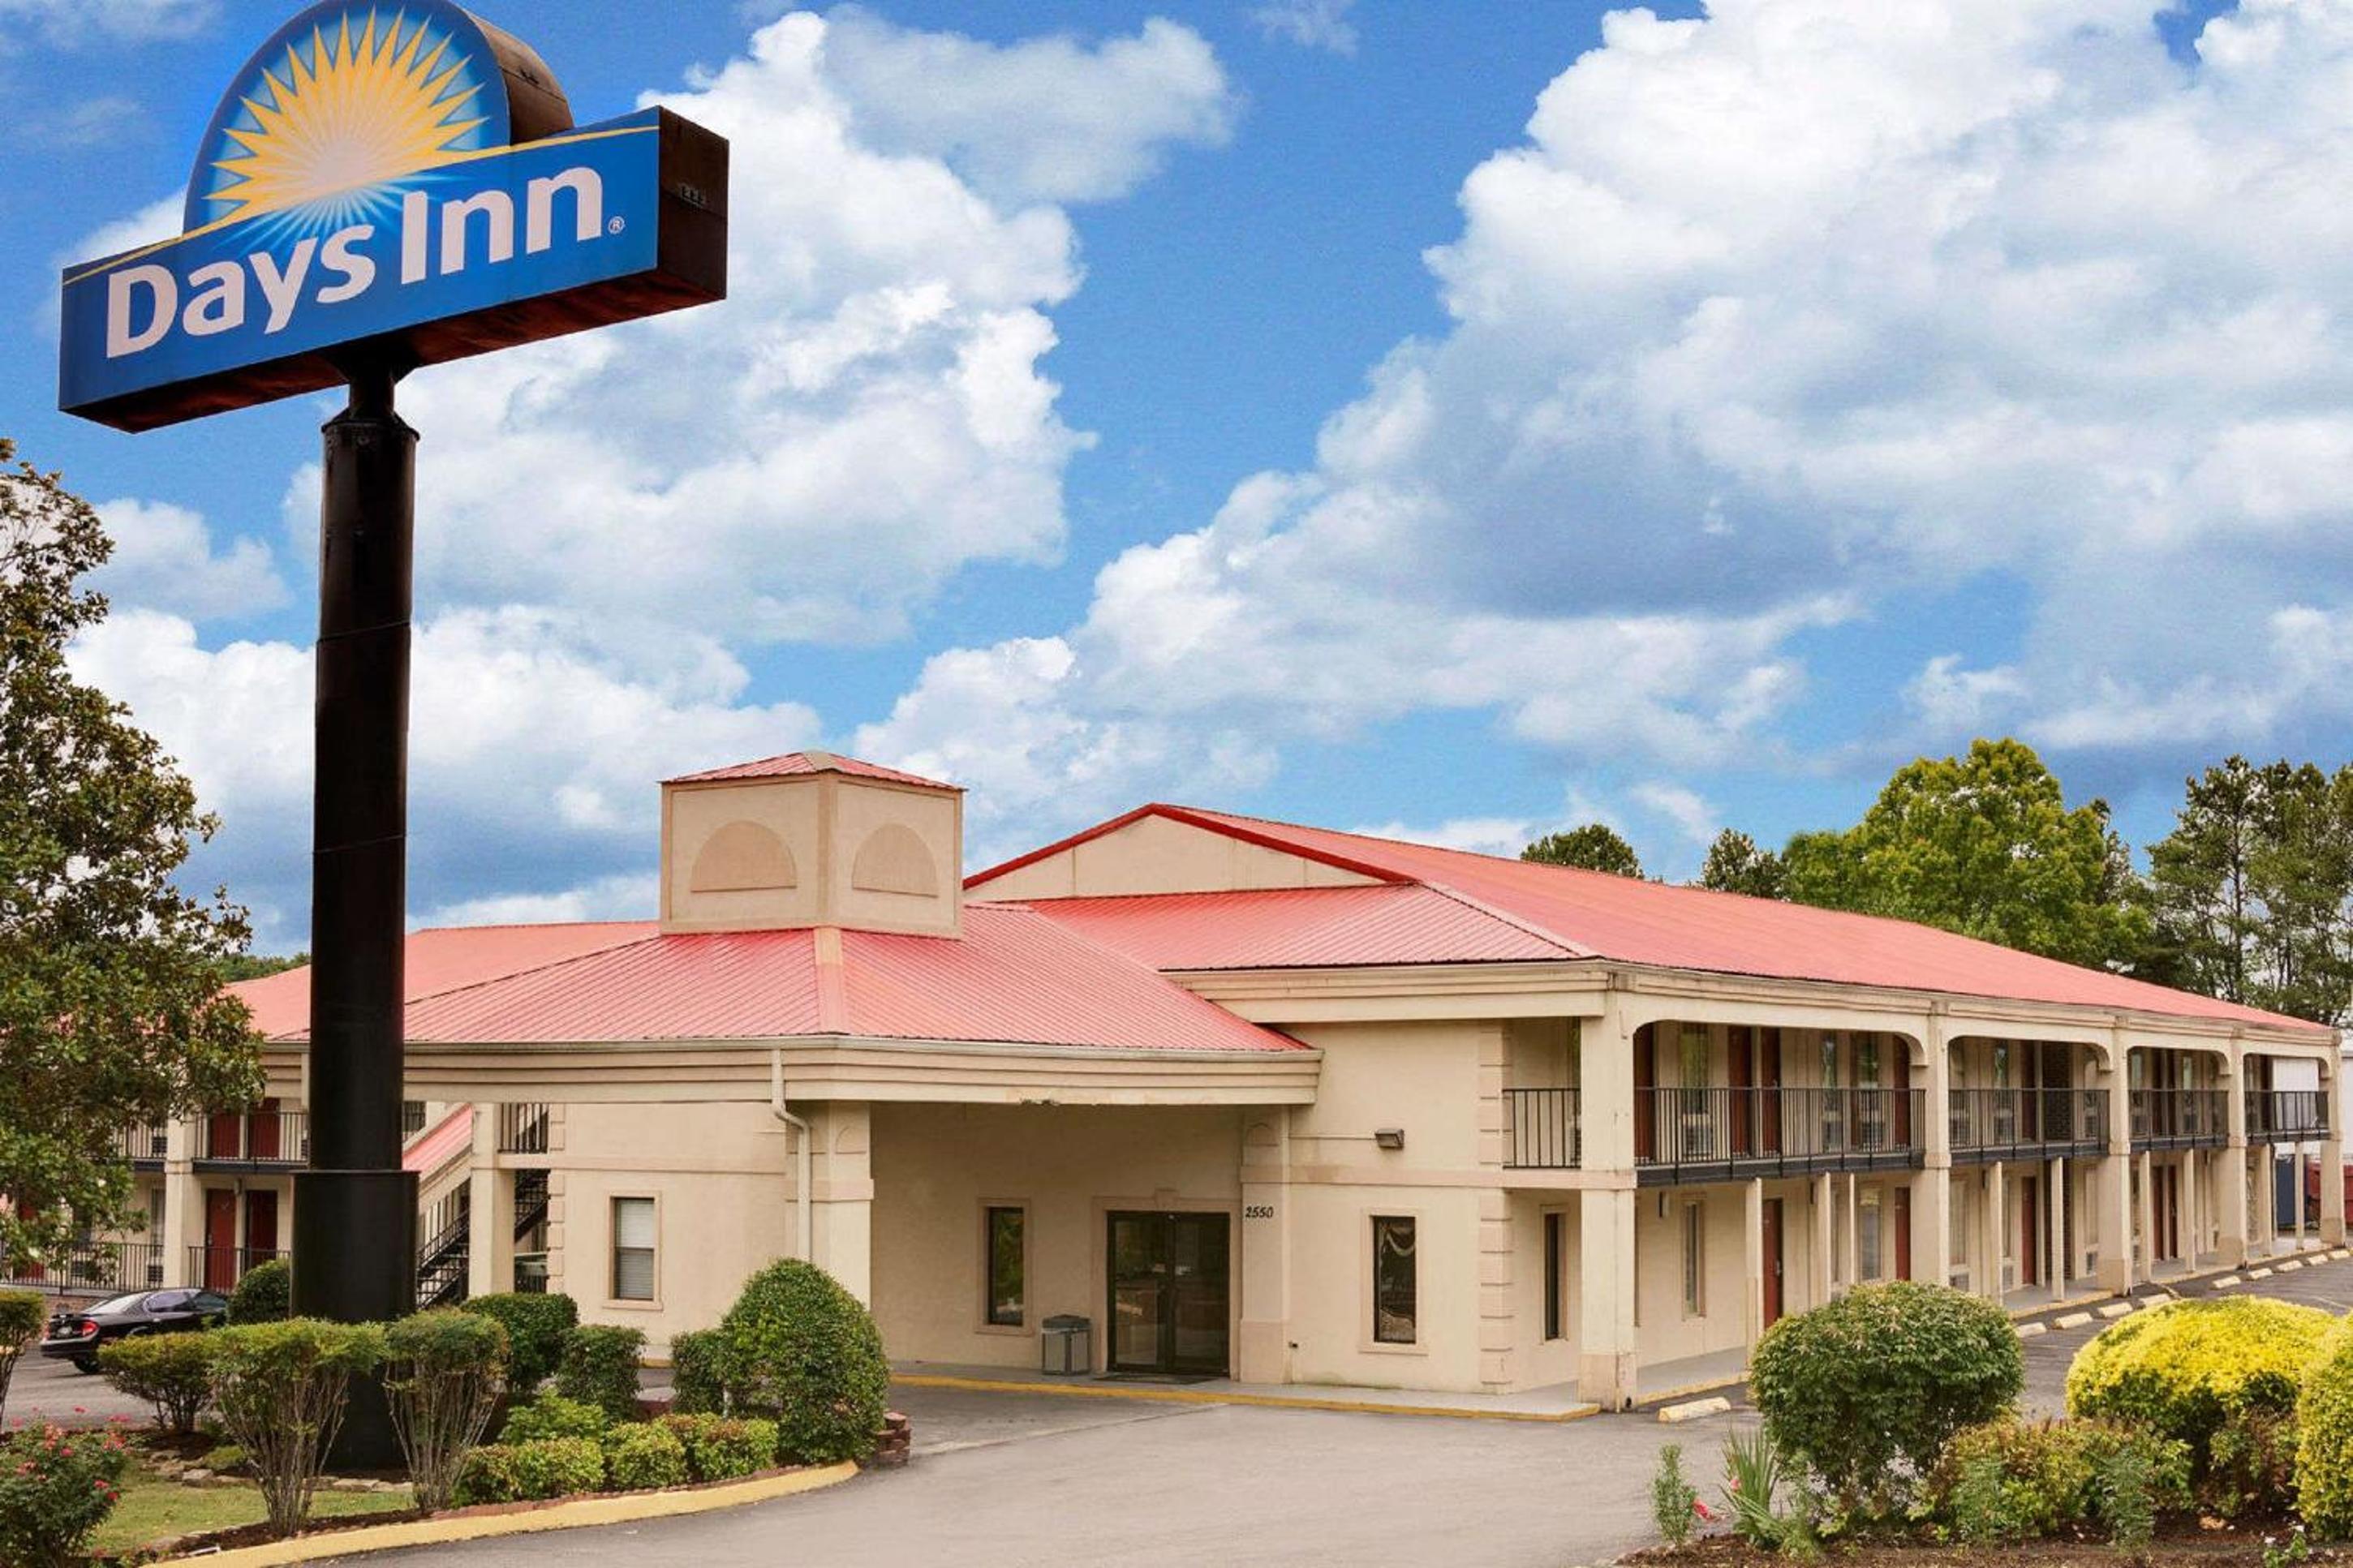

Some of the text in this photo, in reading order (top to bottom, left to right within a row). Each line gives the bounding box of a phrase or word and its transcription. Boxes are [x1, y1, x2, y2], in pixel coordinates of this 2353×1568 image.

[107, 224, 376, 358] Days
[401, 166, 603, 285] Inn
[1245, 1205, 1274, 1218] 2550
